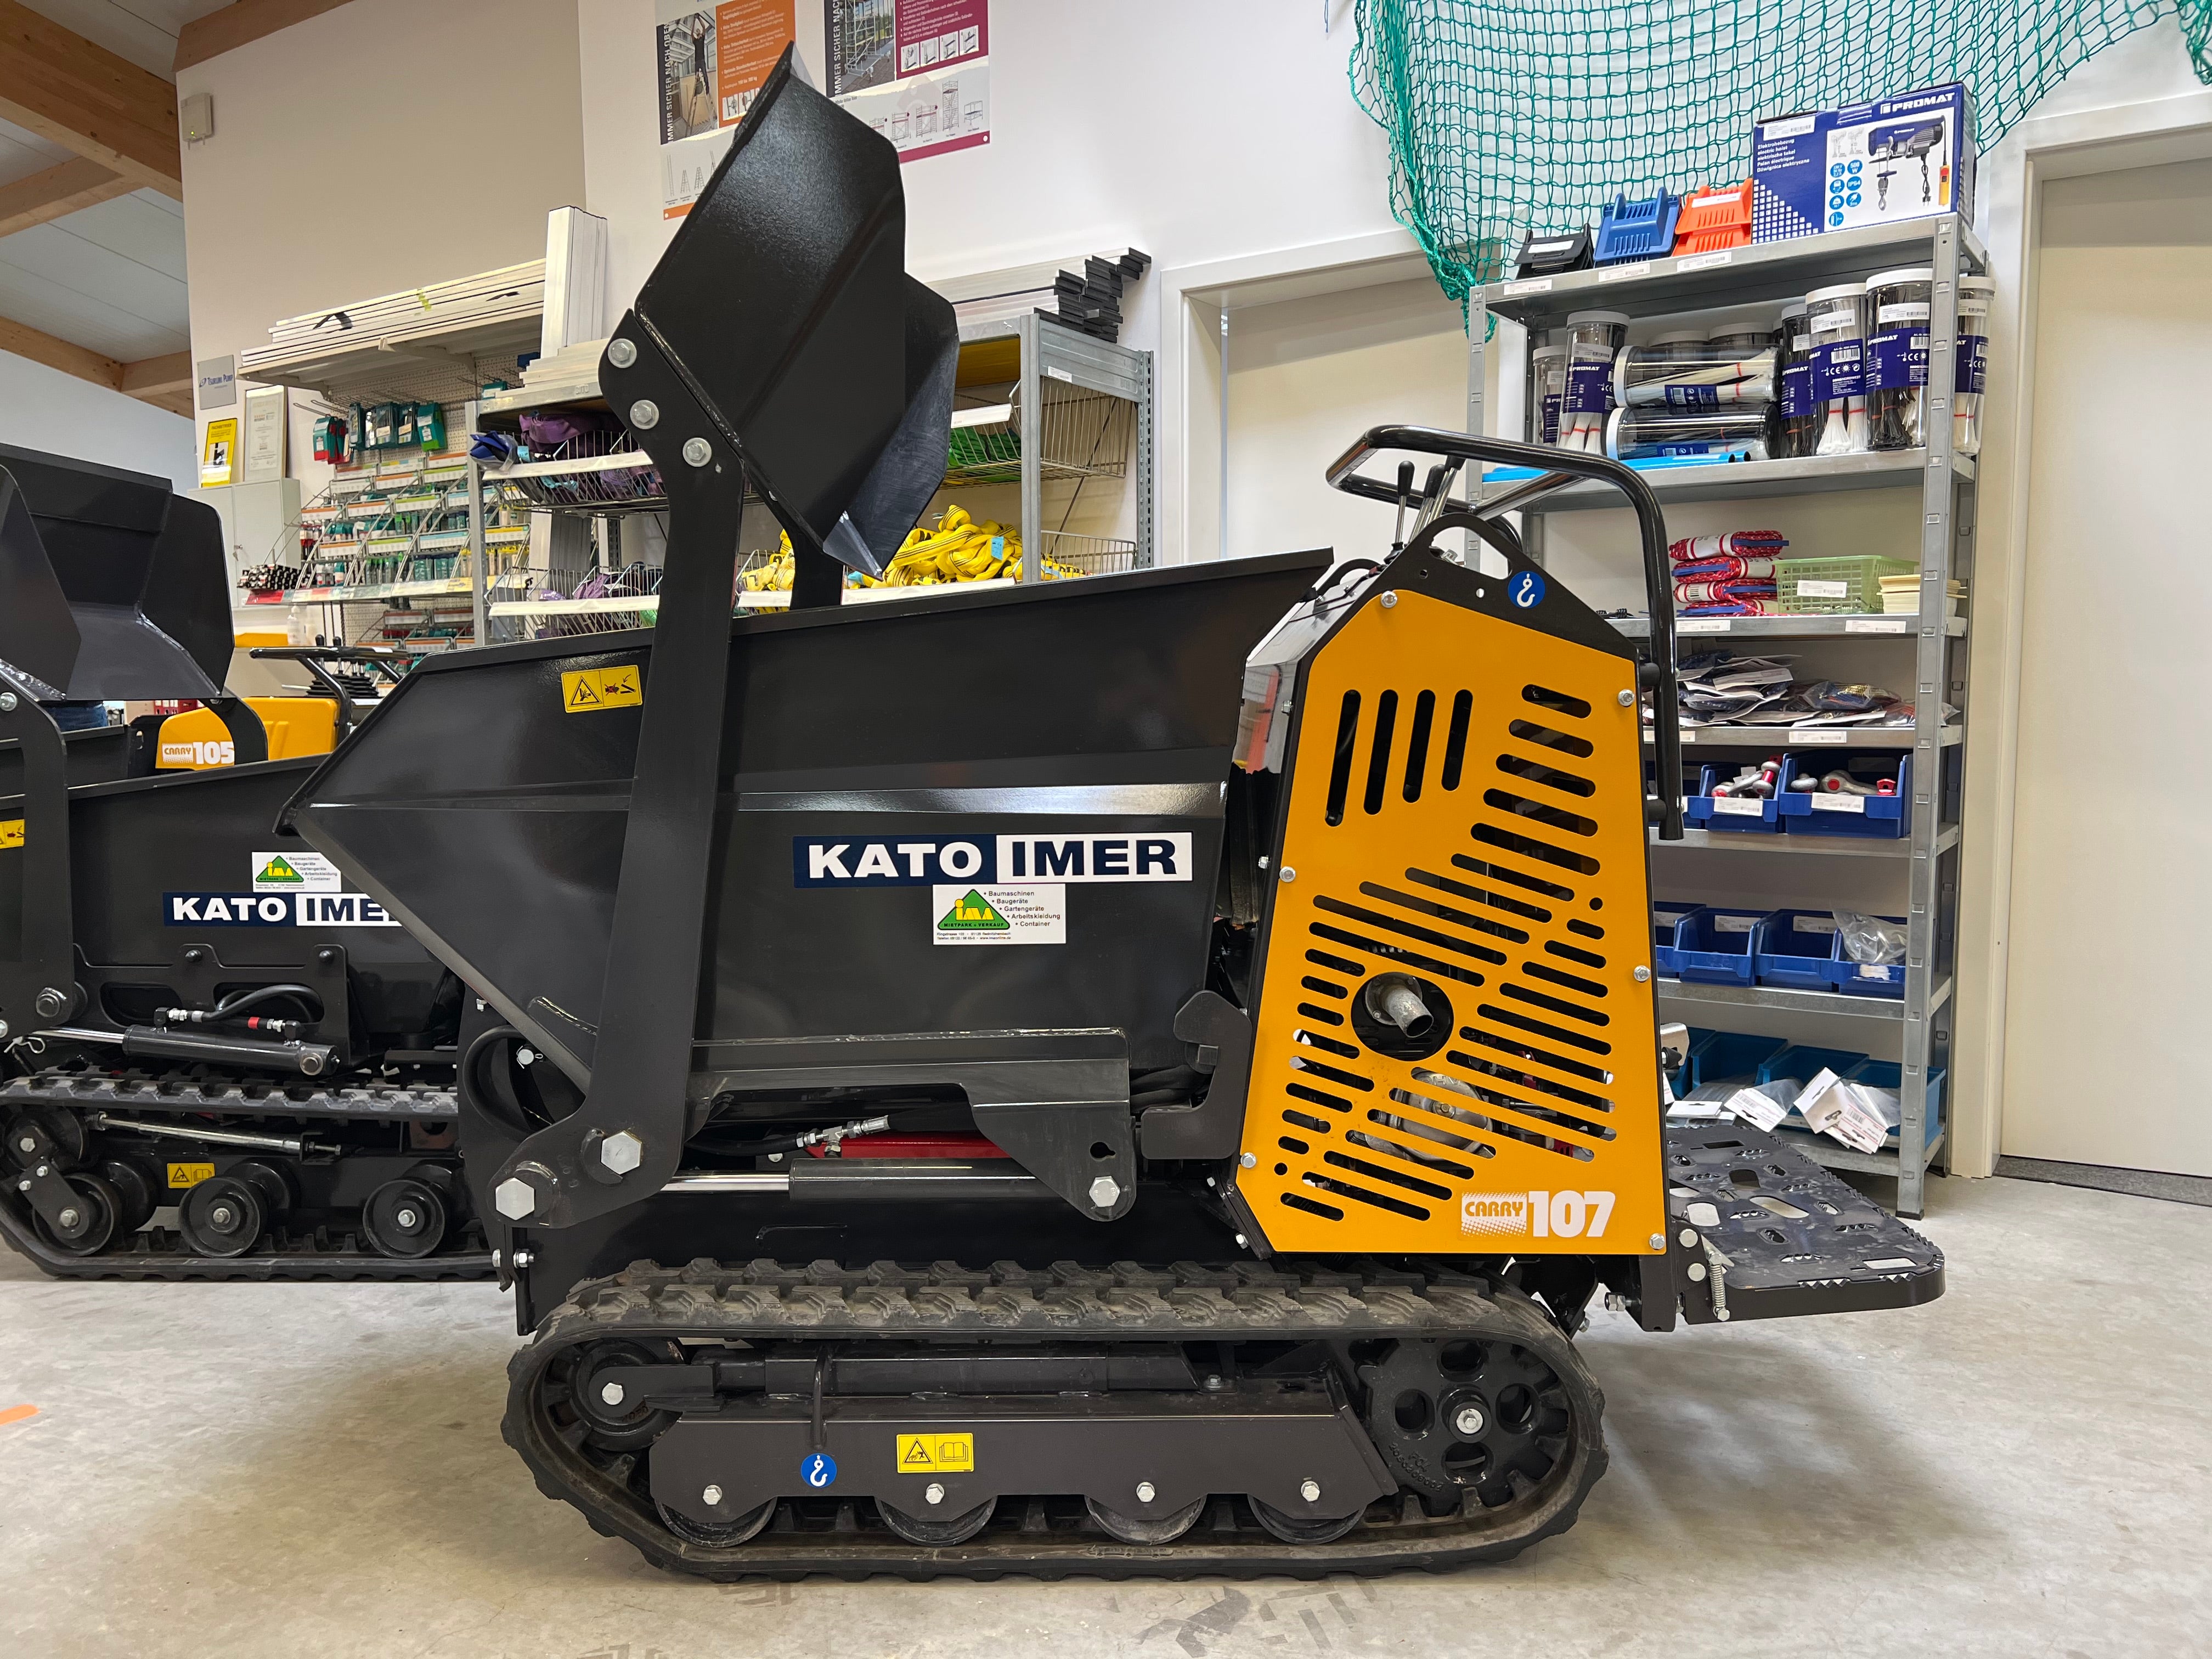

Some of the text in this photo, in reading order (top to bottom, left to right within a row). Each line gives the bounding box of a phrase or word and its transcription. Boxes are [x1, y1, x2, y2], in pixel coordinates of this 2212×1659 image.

[1892, 92, 1955, 112] PROMAT
[1869, 335, 1898, 345] PROMAT
[193, 741, 235, 765] 105
[809, 839, 1176, 878] KATO IMER
[172, 897, 393, 922] KATO IME
[1464, 1190, 1616, 1238] CARRY 107
